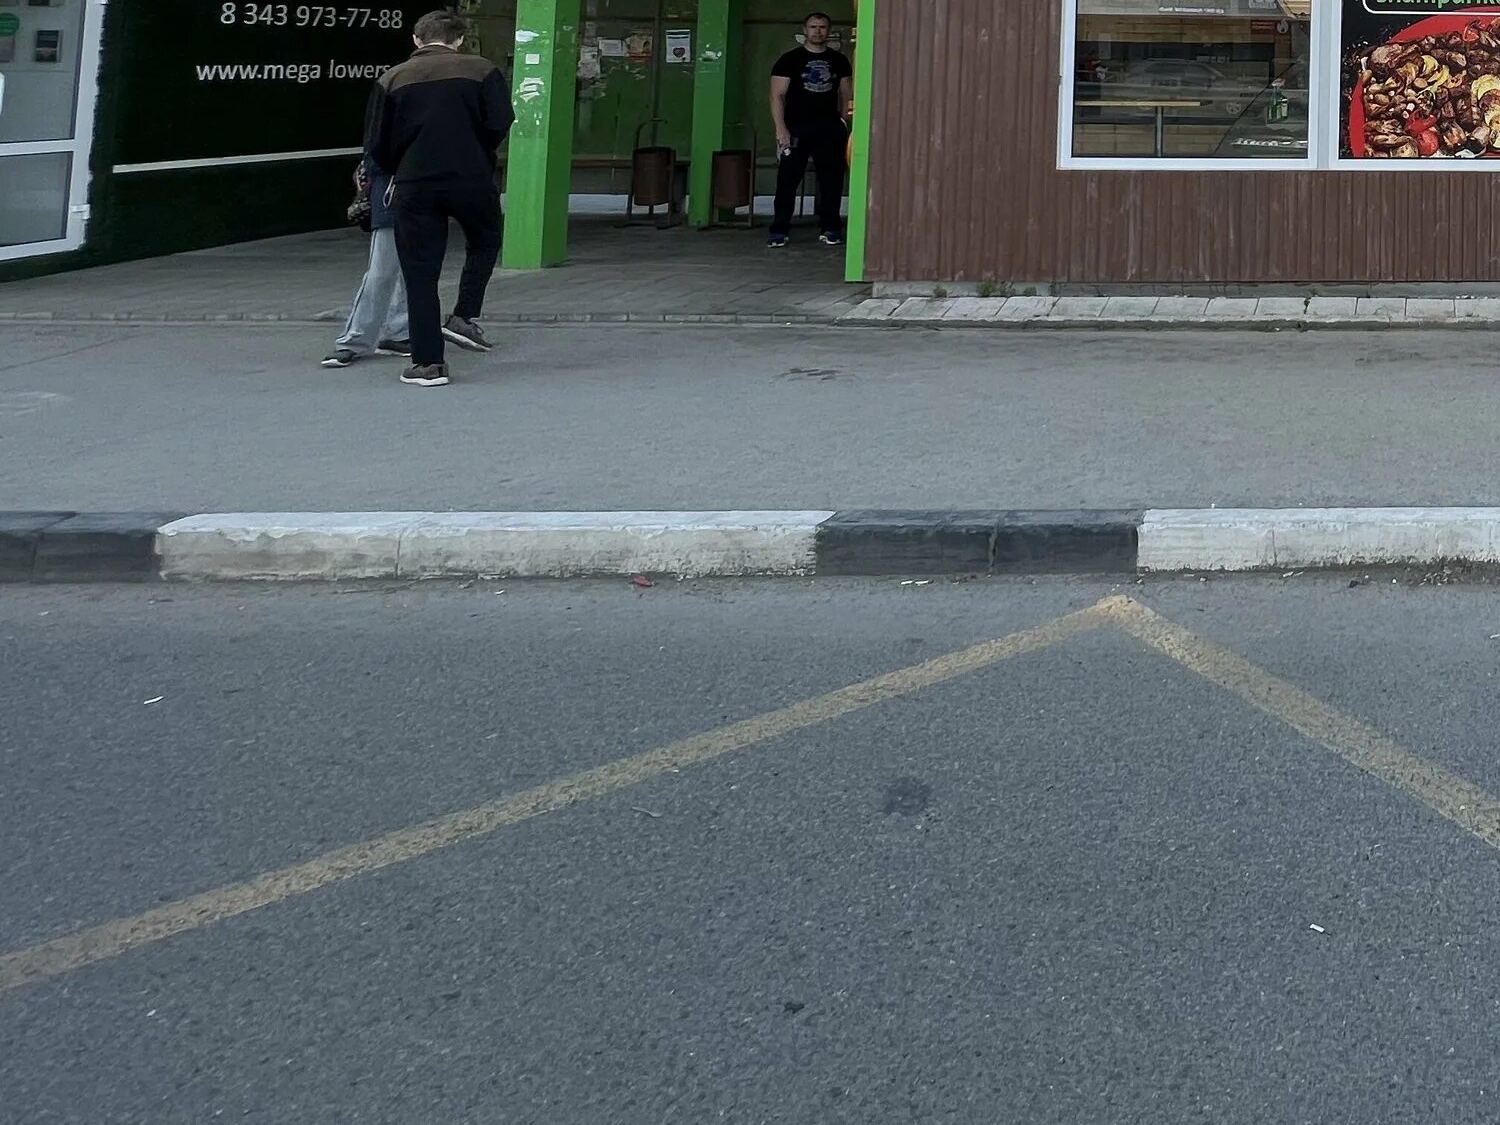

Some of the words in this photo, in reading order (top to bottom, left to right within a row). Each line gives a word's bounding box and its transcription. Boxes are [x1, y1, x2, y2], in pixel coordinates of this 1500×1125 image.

[220, 1, 236, 24] 8
[243, 2, 288, 26] 343
[296, 5, 403, 29] 973-77-88
